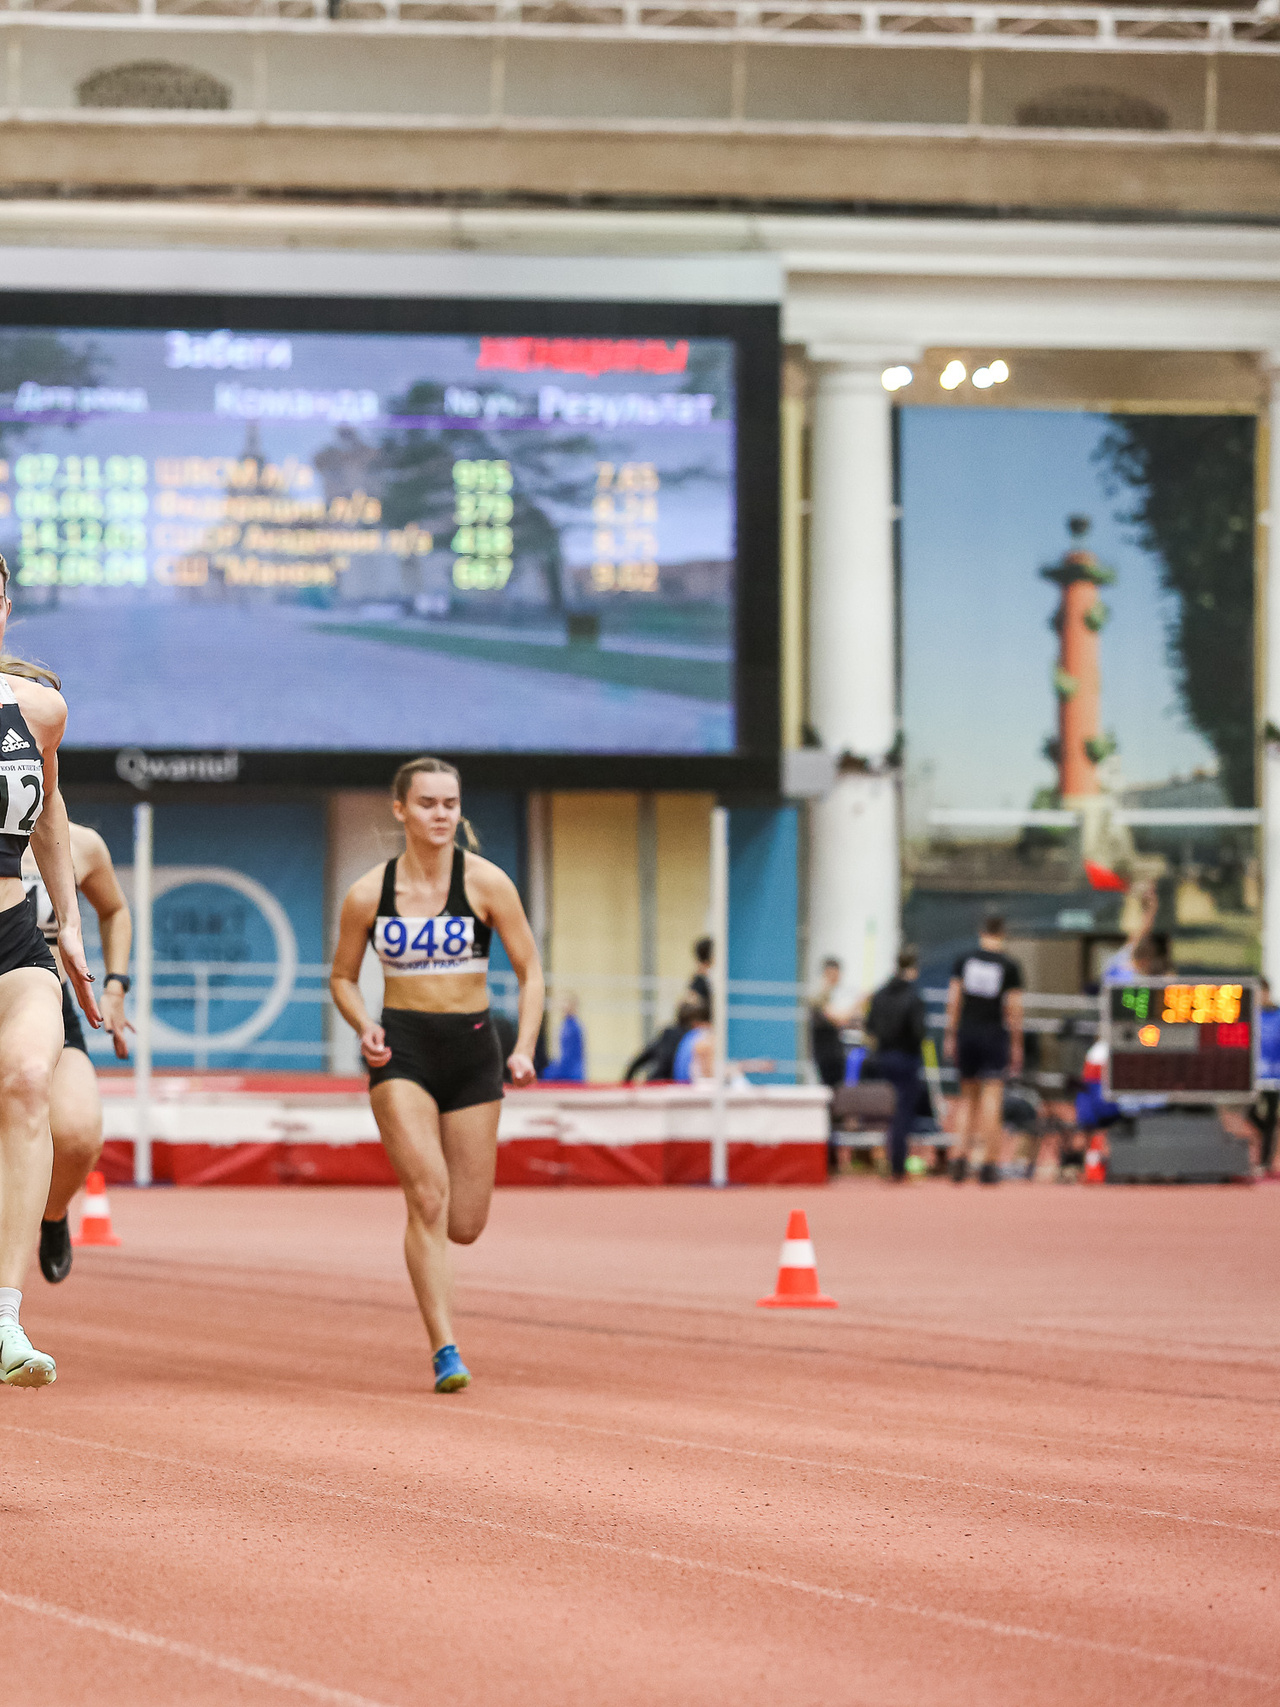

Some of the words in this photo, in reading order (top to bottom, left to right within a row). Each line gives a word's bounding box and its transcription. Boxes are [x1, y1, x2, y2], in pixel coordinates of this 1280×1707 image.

[165, 331, 292, 370] Забеги
[215, 386, 378, 422] Команда
[538, 386, 715, 427] Результат
[154, 555, 208, 586] СШ
[1, 741, 30, 752] adidas
[383, 916, 468, 958] 948
